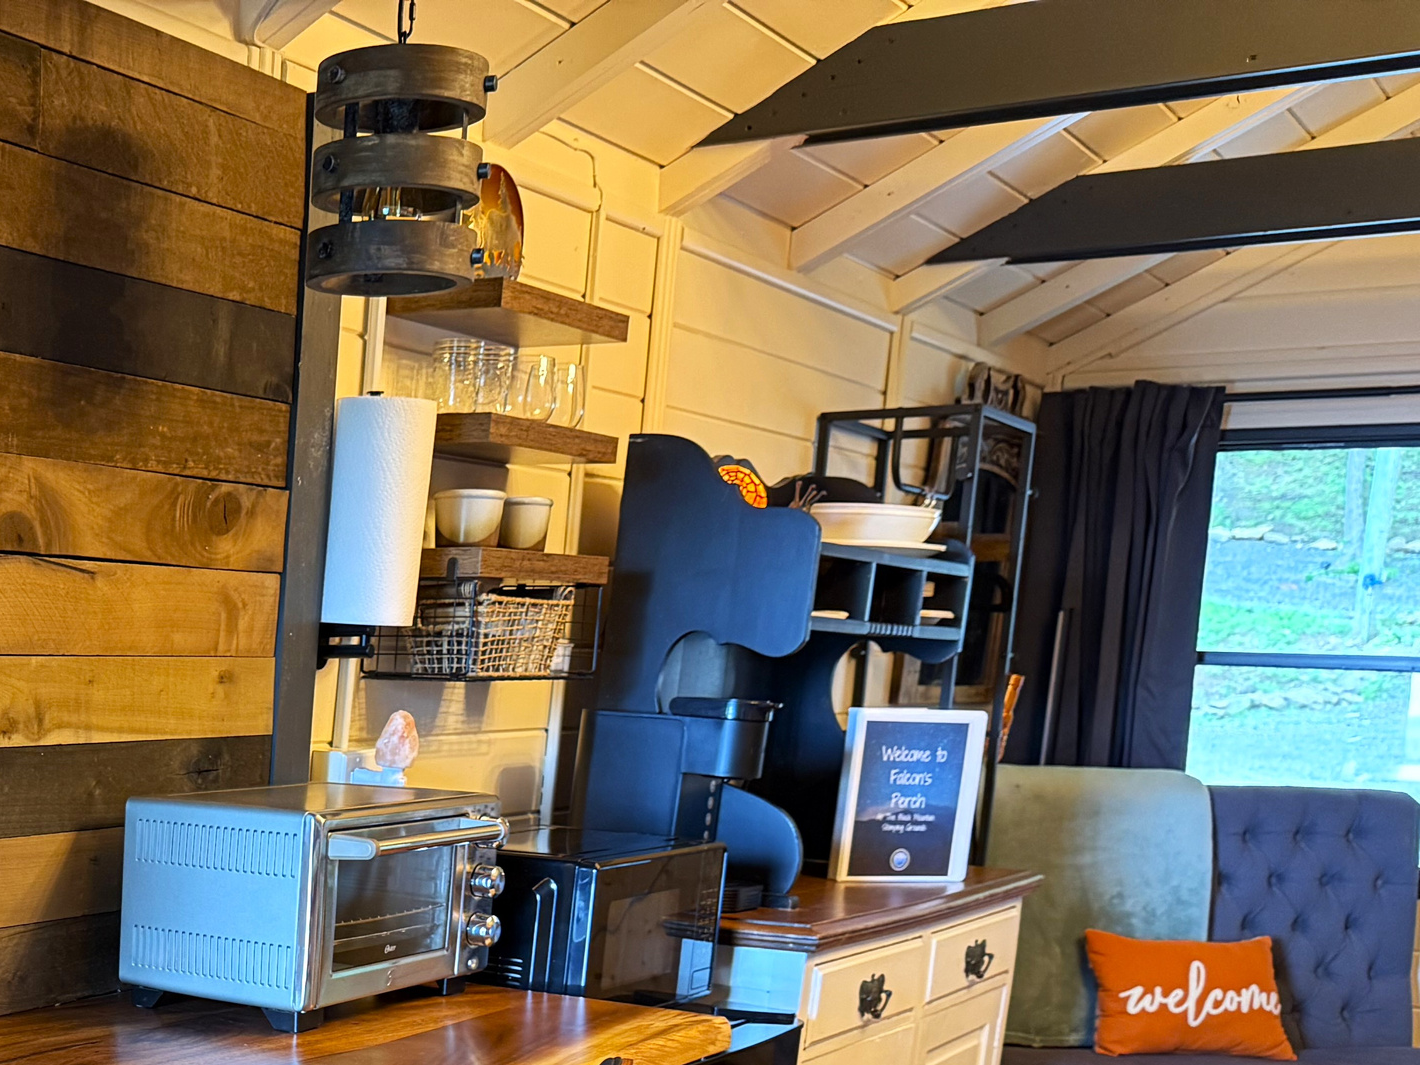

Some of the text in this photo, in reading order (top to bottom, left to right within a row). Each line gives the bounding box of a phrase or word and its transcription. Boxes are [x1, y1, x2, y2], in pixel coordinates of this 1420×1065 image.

[882, 745, 948, 763] Welcome to
[890, 769, 932, 785] Falcon's
[890, 792, 926, 808] Perch
[1119, 960, 1282, 1027] welcome
